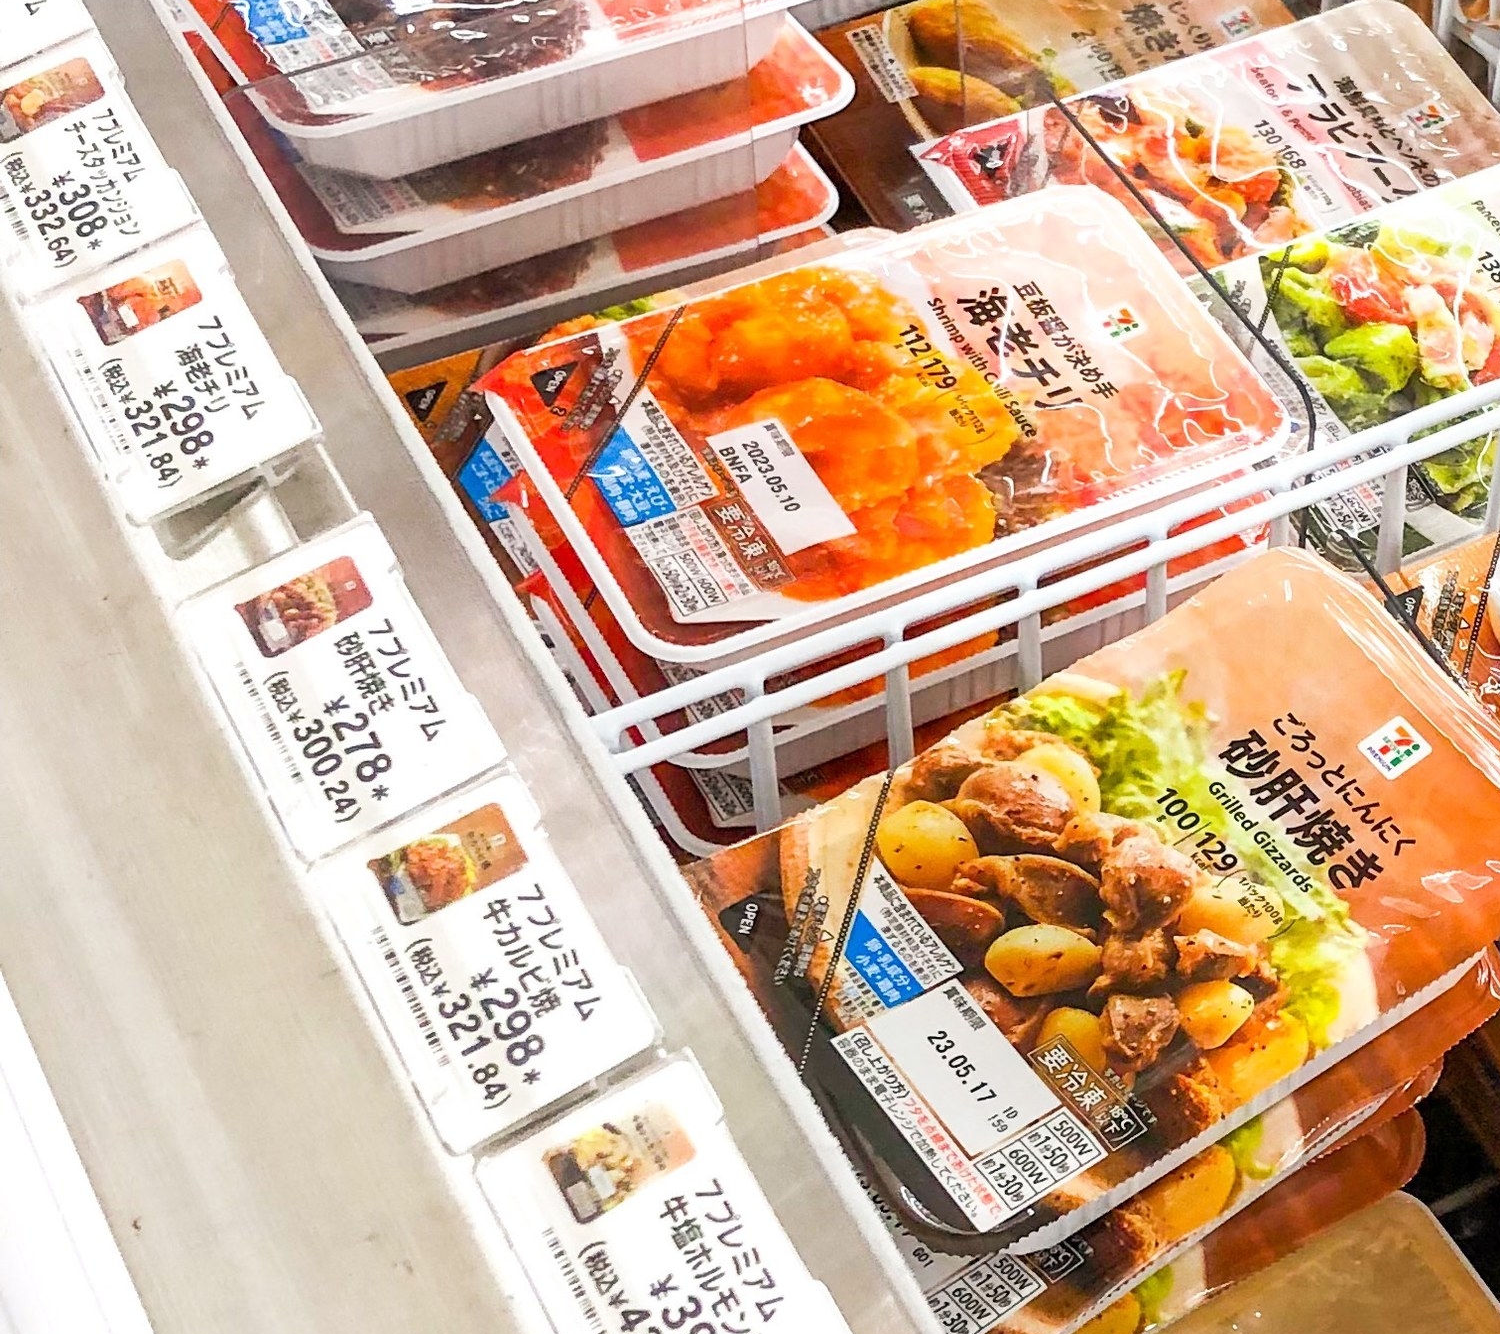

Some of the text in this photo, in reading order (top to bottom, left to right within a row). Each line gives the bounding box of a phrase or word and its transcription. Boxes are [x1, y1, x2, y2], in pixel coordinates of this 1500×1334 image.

[90, 107, 146, 182] 7プレミアム
[1253, 119, 1307, 171] 130 168
[197, 315, 266, 420] 7プレミアム
[899, 323, 957, 390] 112 179
[927, 296, 1038, 439] Shrimp with Sauce
[956, 286, 1084, 410] 海老チリ
[1012, 279, 1120, 399] 豆板醤が決め手
[174, 343, 230, 414] 海老チリ
[98, 357, 183, 489] (税込¥321.84)
[718, 446, 753, 485] BNFA
[741, 440, 801, 513] 2023.05.10
[715, 503, 769, 561] 要冷凍
[332, 631, 396, 717] 砂肝焼き
[367, 617, 447, 742] 7プレミアム
[262, 669, 363, 824] (税込¥300.24)
[1366, 745, 1393, 772] PREMIUM
[1218, 728, 1385, 890] 砂肝焼き
[1272, 712, 1417, 857] ごろっとにんにく
[1156, 787, 1239, 872] 100 129
[1207, 781, 1314, 894] Grilled Gizzards
[517, 883, 602, 1022] 7プレミアム
[738, 902, 758, 936] OPEN
[482, 897, 562, 1019] 牛カルビ焼
[404, 937, 512, 1111] (税込¥321.84)
[942, 984, 988, 1032] 賞味期限
[927, 1029, 998, 1104] 23.05.17
[1040, 1045, 1107, 1112] 要冷凍
[1008, 1147, 1049, 1187] 600W
[1028, 1130, 1072, 1175] 約1分50秒
[1052, 1117, 1092, 1157] 500W
[983, 1157, 1026, 1204] 約1分30秒
[695, 1177, 785, 1323] 7プレミアム
[993, 1256, 1034, 1291] 500W
[951, 1286, 992, 1321] 600W
